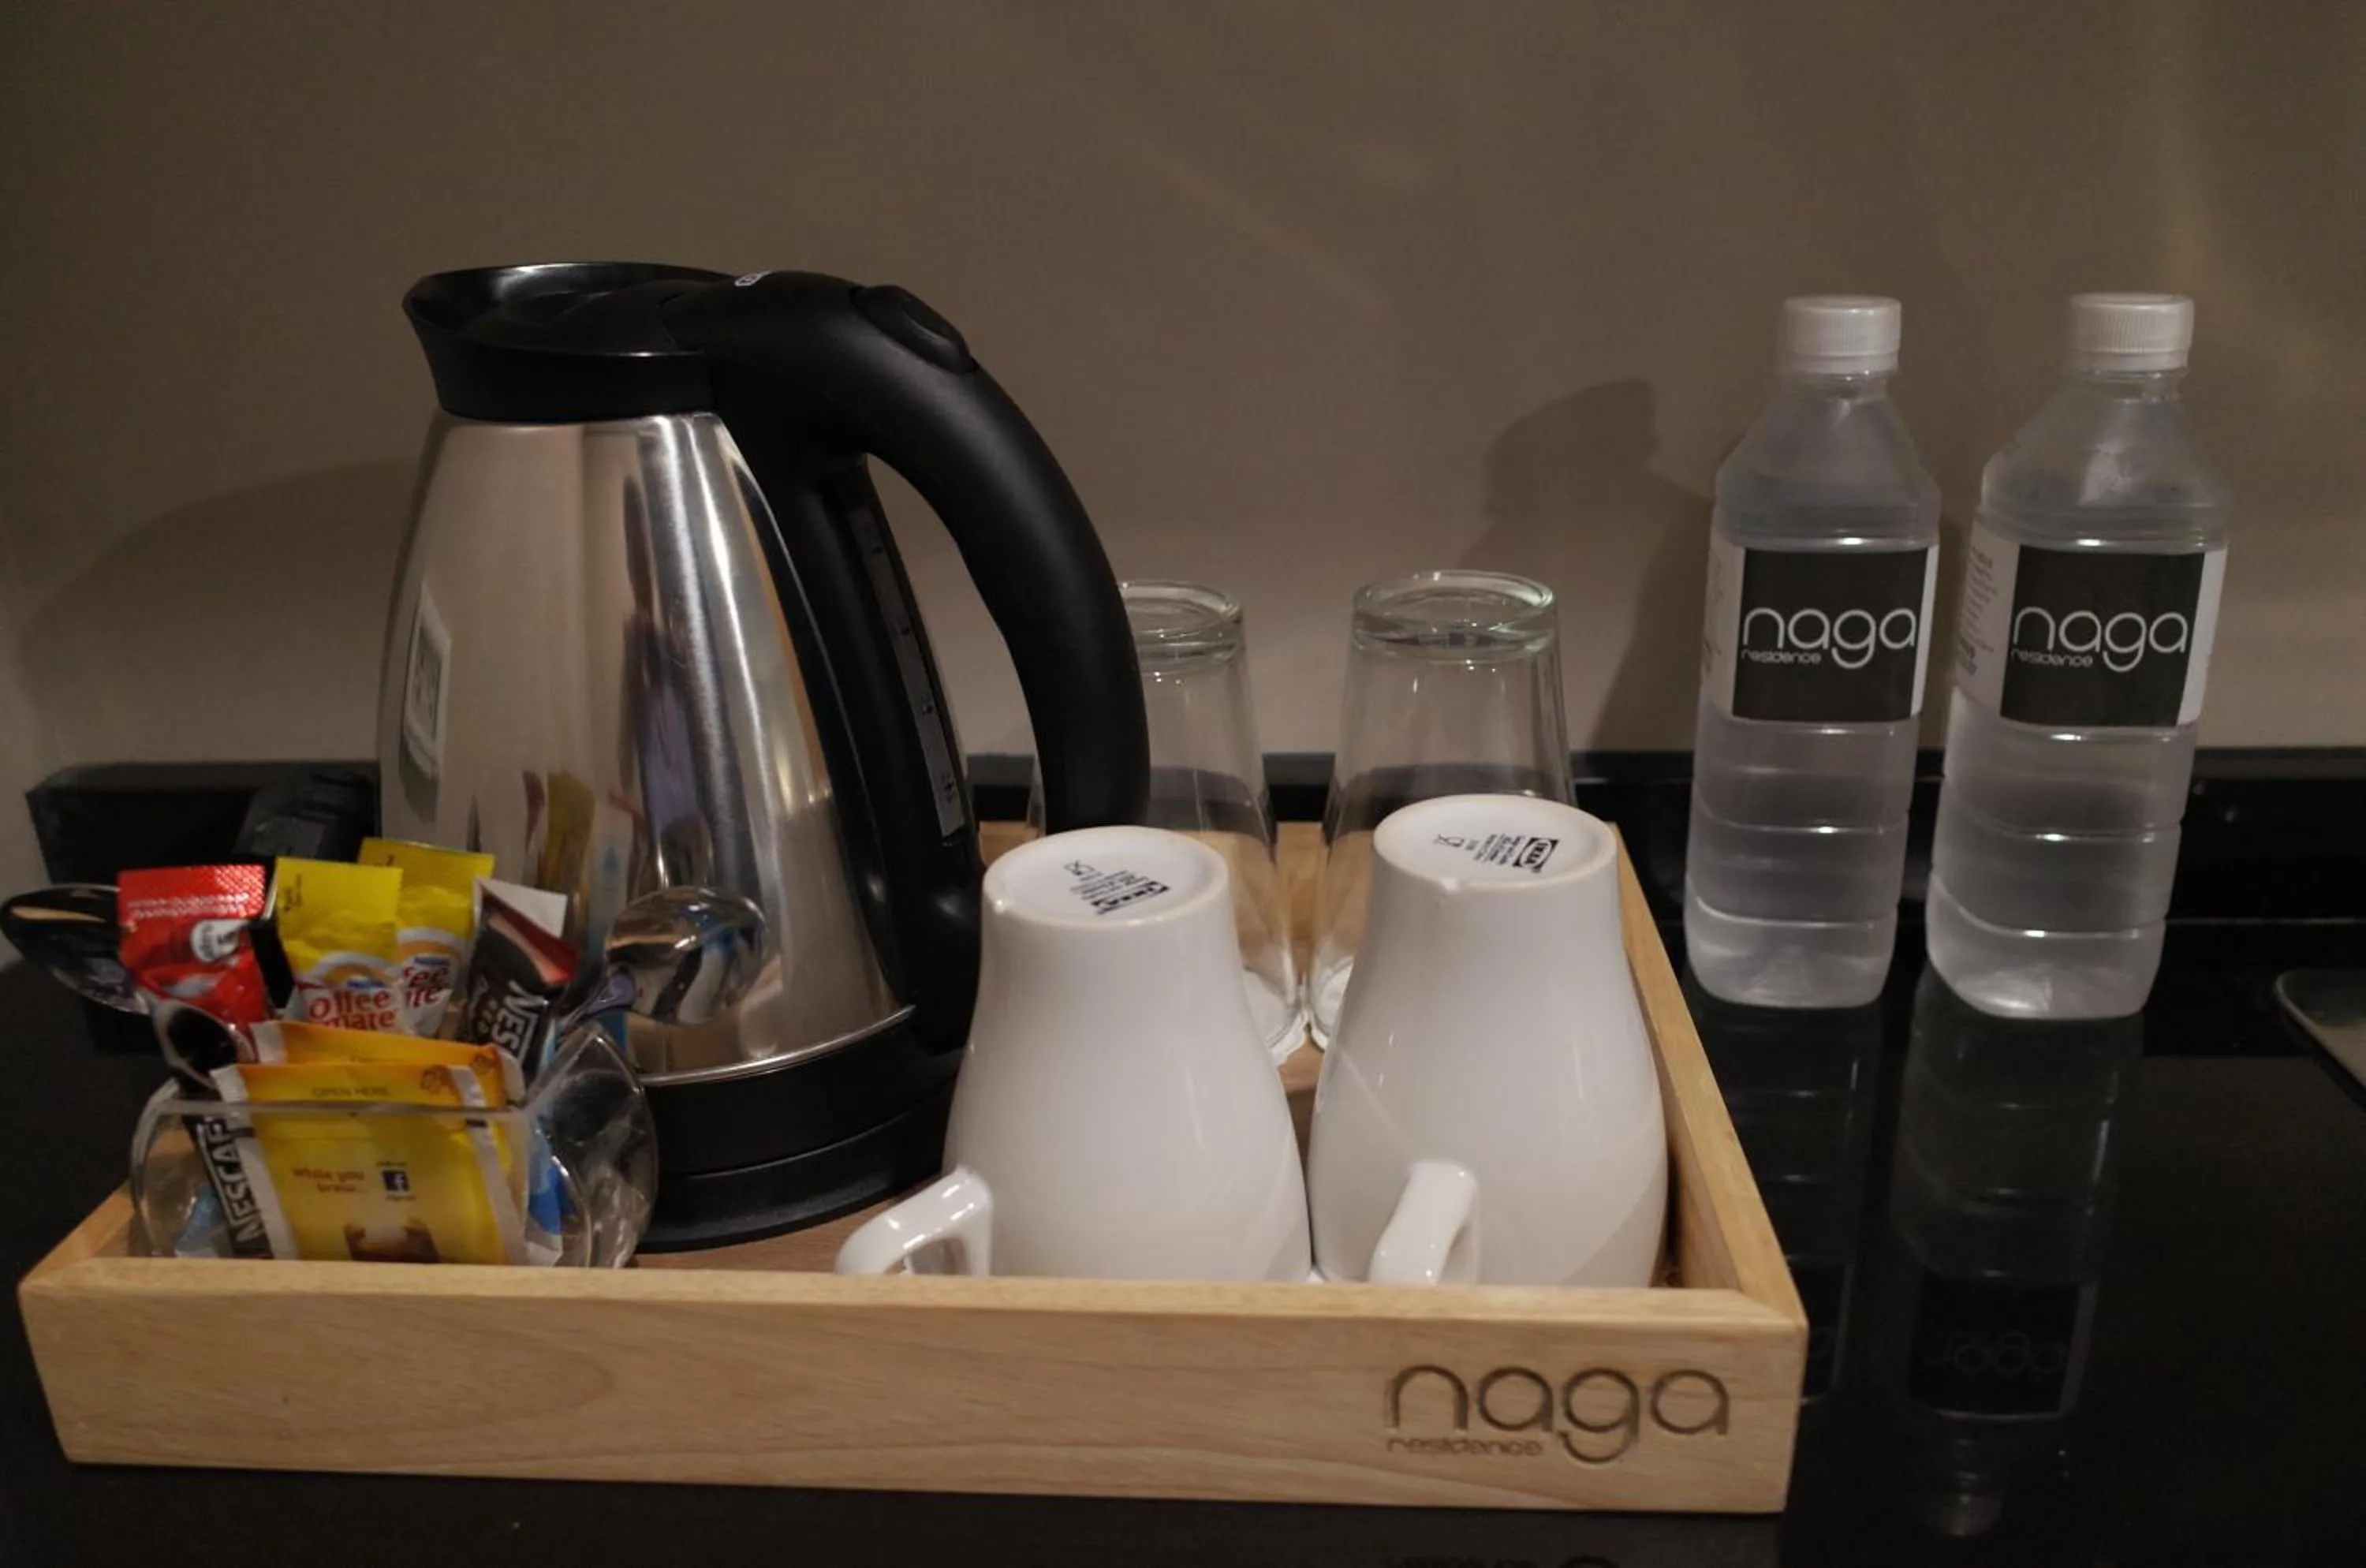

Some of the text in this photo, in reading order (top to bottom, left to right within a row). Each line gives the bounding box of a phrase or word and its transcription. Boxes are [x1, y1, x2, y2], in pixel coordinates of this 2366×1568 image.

[1741, 649, 1822, 665] residence
[1742, 606, 1917, 670] naga
[2010, 648, 2094, 668] residence
[2013, 605, 2189, 673] naga
[491, 979, 550, 1054] NES
[195, 1118, 266, 1243] NESCAF
[1384, 1363, 1730, 1465] naga
[1386, 1436, 1543, 1457] residence
